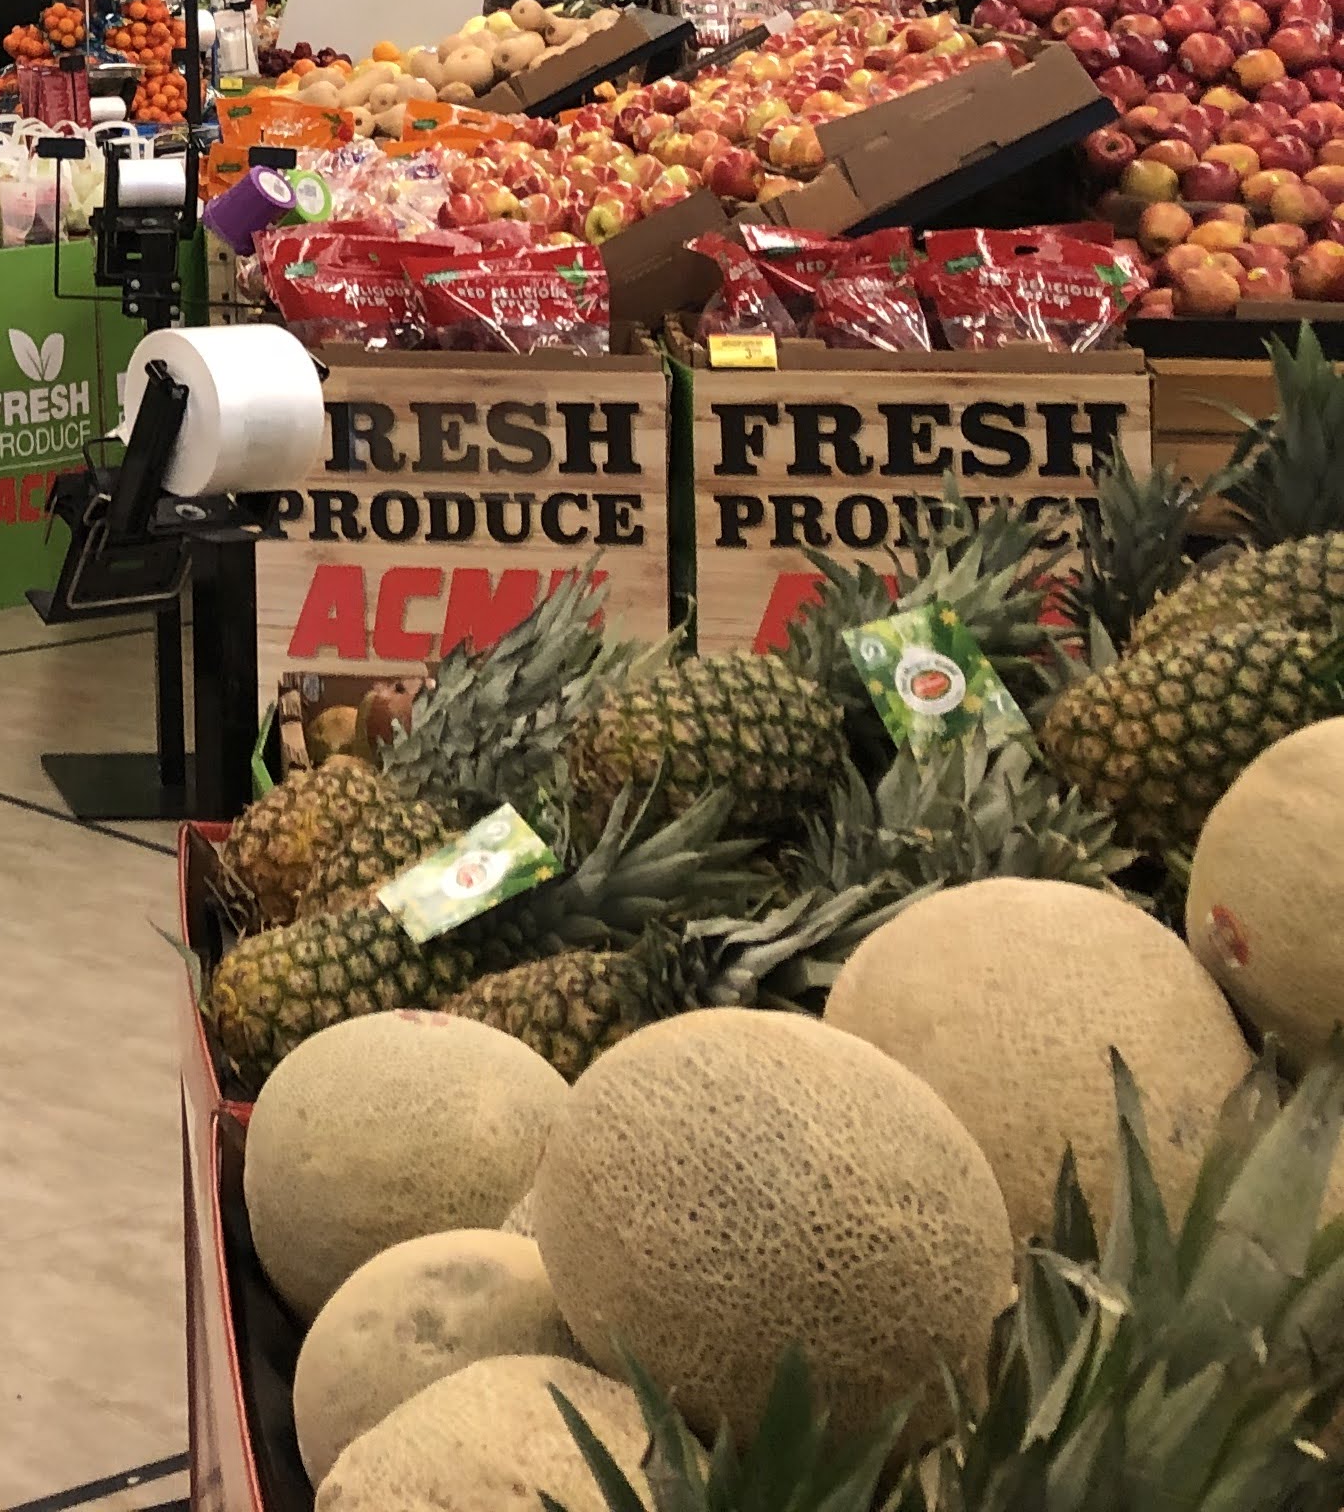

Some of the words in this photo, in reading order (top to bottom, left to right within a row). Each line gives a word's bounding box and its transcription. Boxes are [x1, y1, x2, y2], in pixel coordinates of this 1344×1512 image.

[796, 260, 826, 273] RED
[324, 401, 642, 475] RESH
[711, 401, 1128, 478] FRESH
[267, 489, 644, 546] PRODUCE
